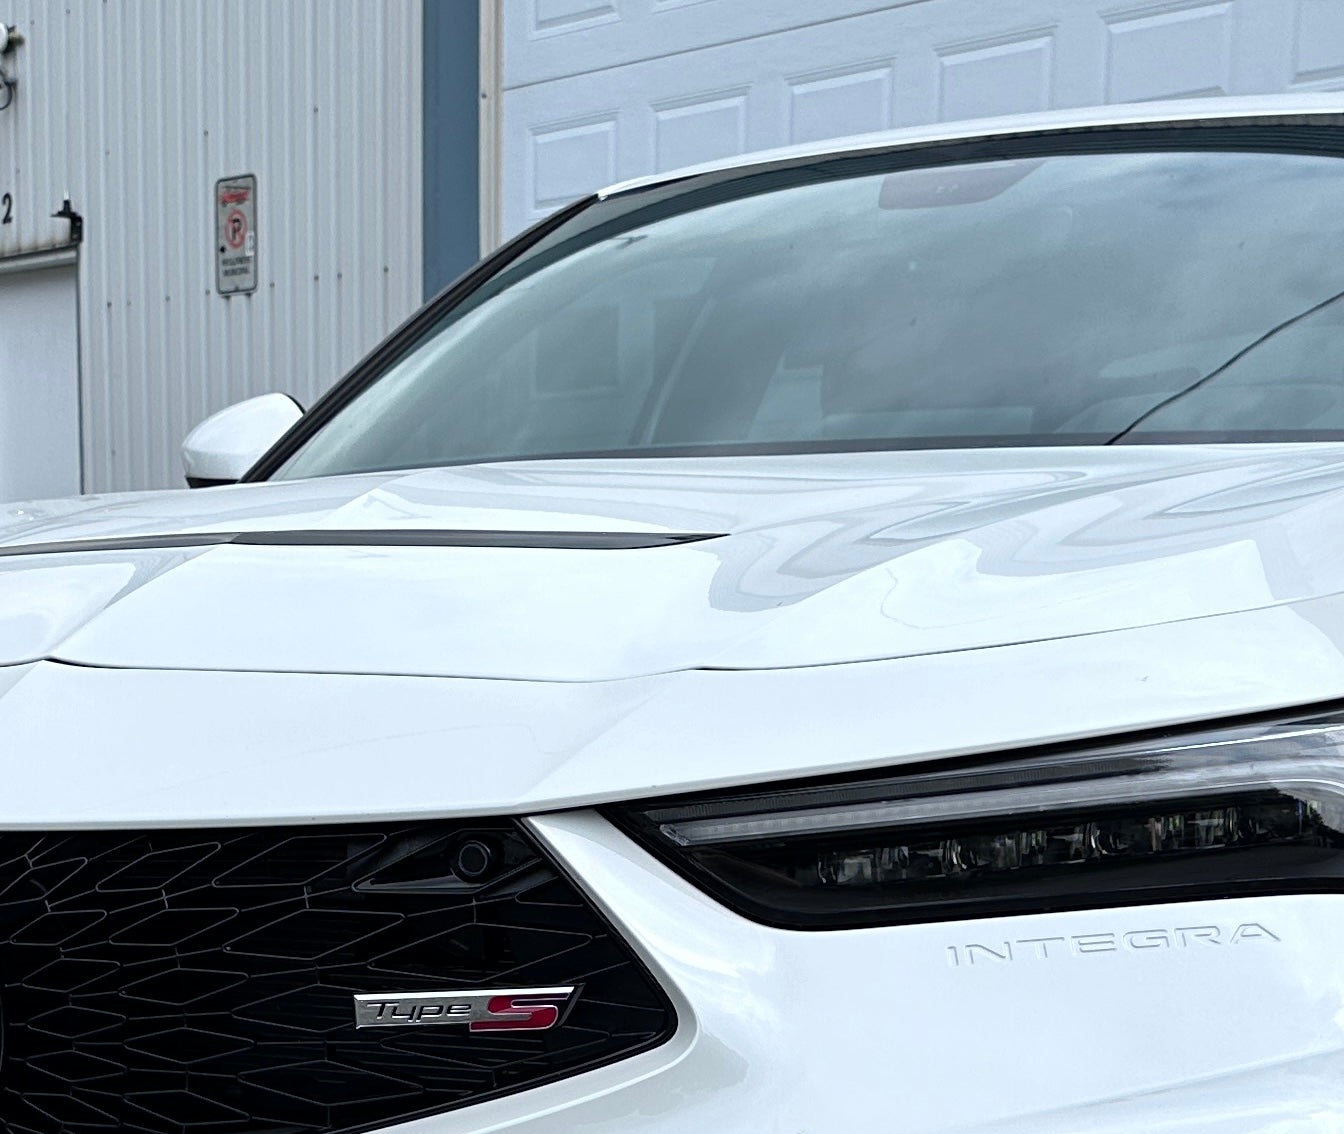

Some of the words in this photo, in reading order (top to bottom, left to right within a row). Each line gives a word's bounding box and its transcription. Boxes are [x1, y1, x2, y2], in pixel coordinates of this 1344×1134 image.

[2, 192, 13, 225] 2
[946, 922, 1282, 967] INTEGRA
[367, 1001, 472, 1023] Type
[469, 993, 570, 1032] S
